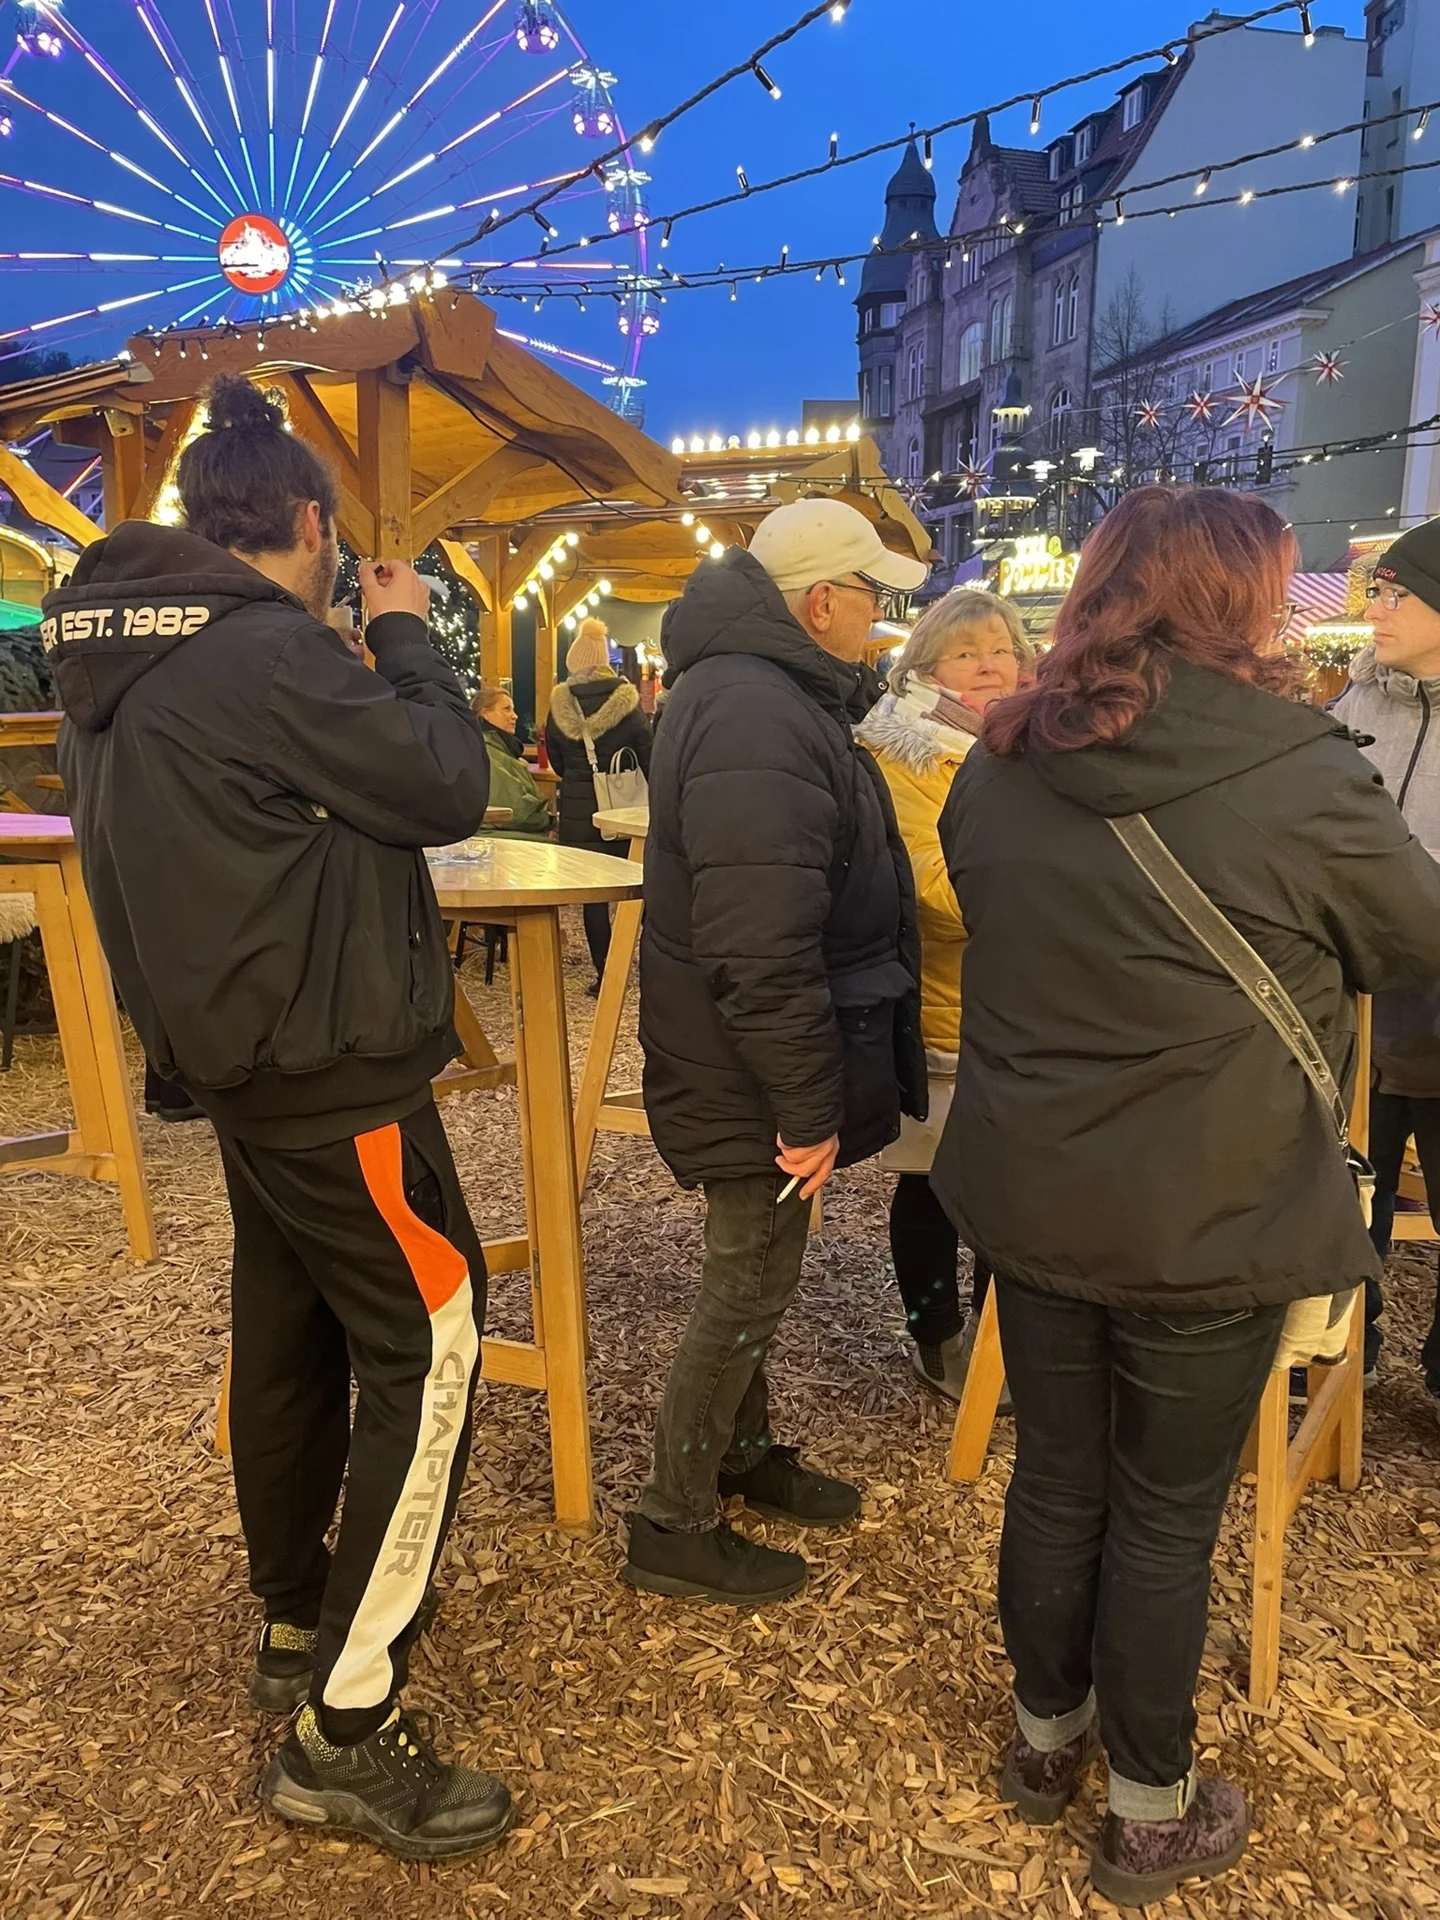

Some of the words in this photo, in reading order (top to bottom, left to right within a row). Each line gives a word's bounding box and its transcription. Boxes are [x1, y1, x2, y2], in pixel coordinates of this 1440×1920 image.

[61, 608, 114, 641] EST.
[122, 606, 210, 637] 1982
[384, 1351, 465, 1577] CHAPTER
